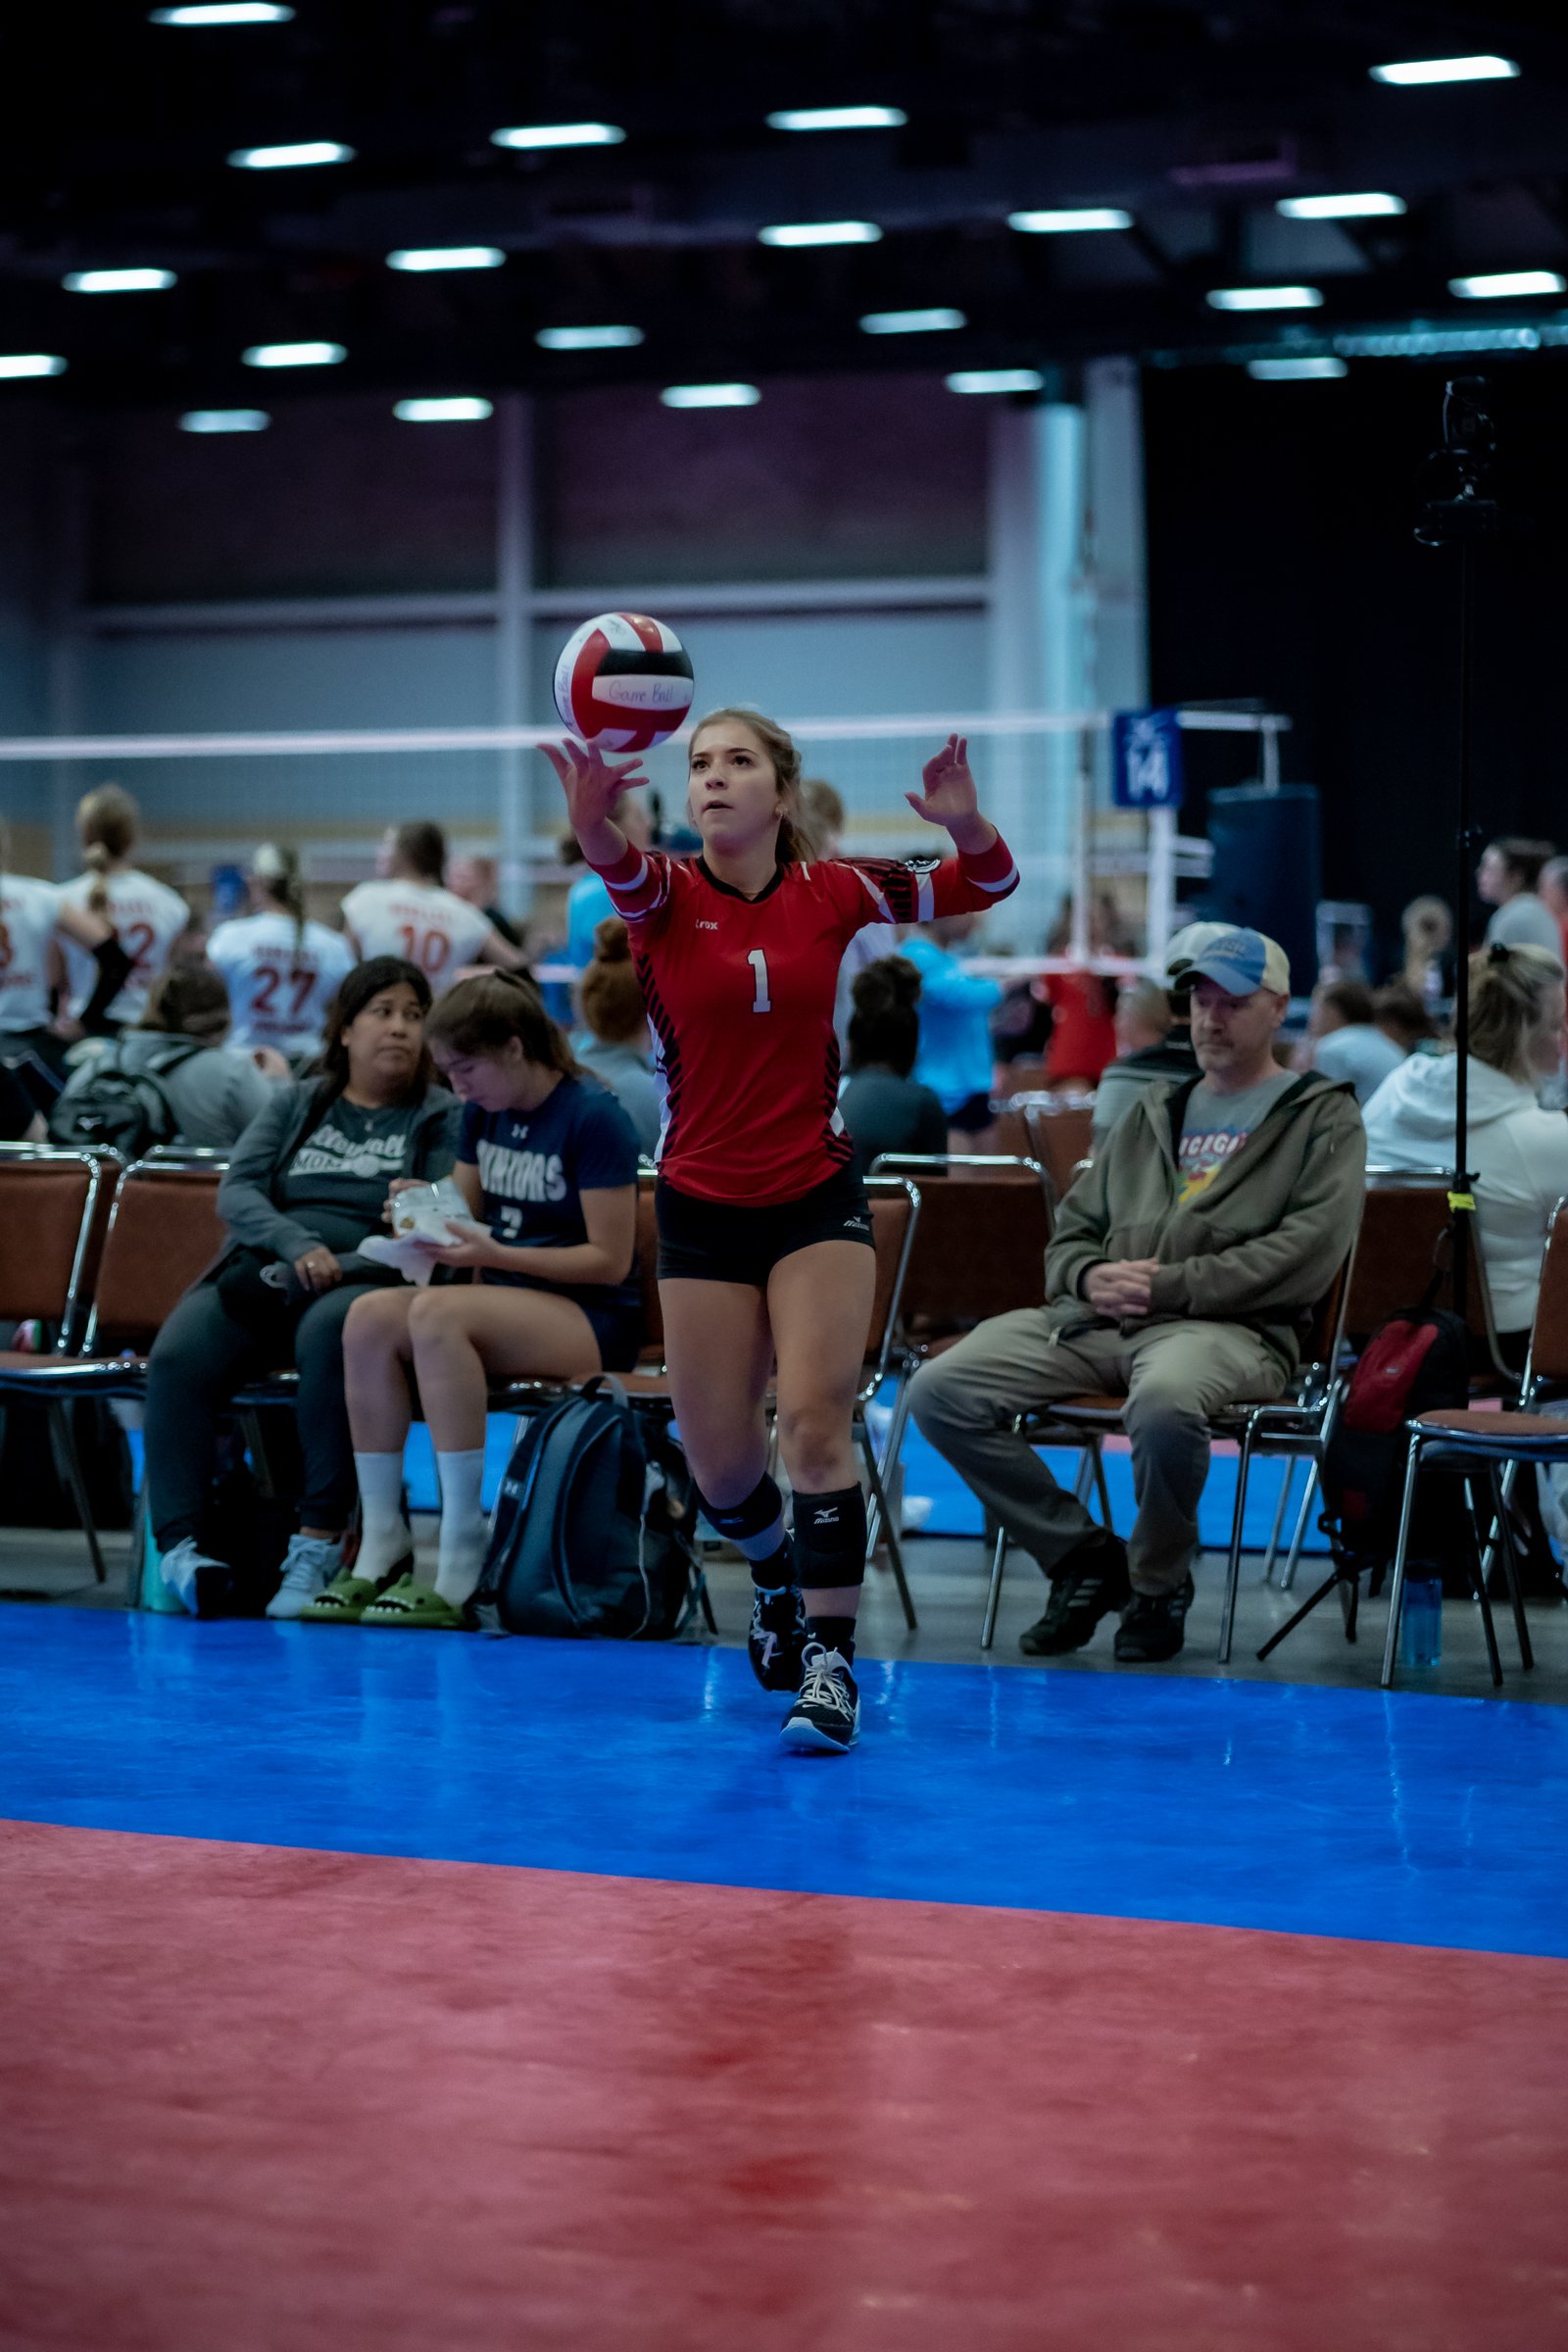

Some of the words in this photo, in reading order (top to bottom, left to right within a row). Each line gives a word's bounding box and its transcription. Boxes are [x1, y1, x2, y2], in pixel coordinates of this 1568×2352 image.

[397, 925, 451, 974] 10
[252, 965, 316, 1015] 27
[746, 948, 772, 1014] 1
